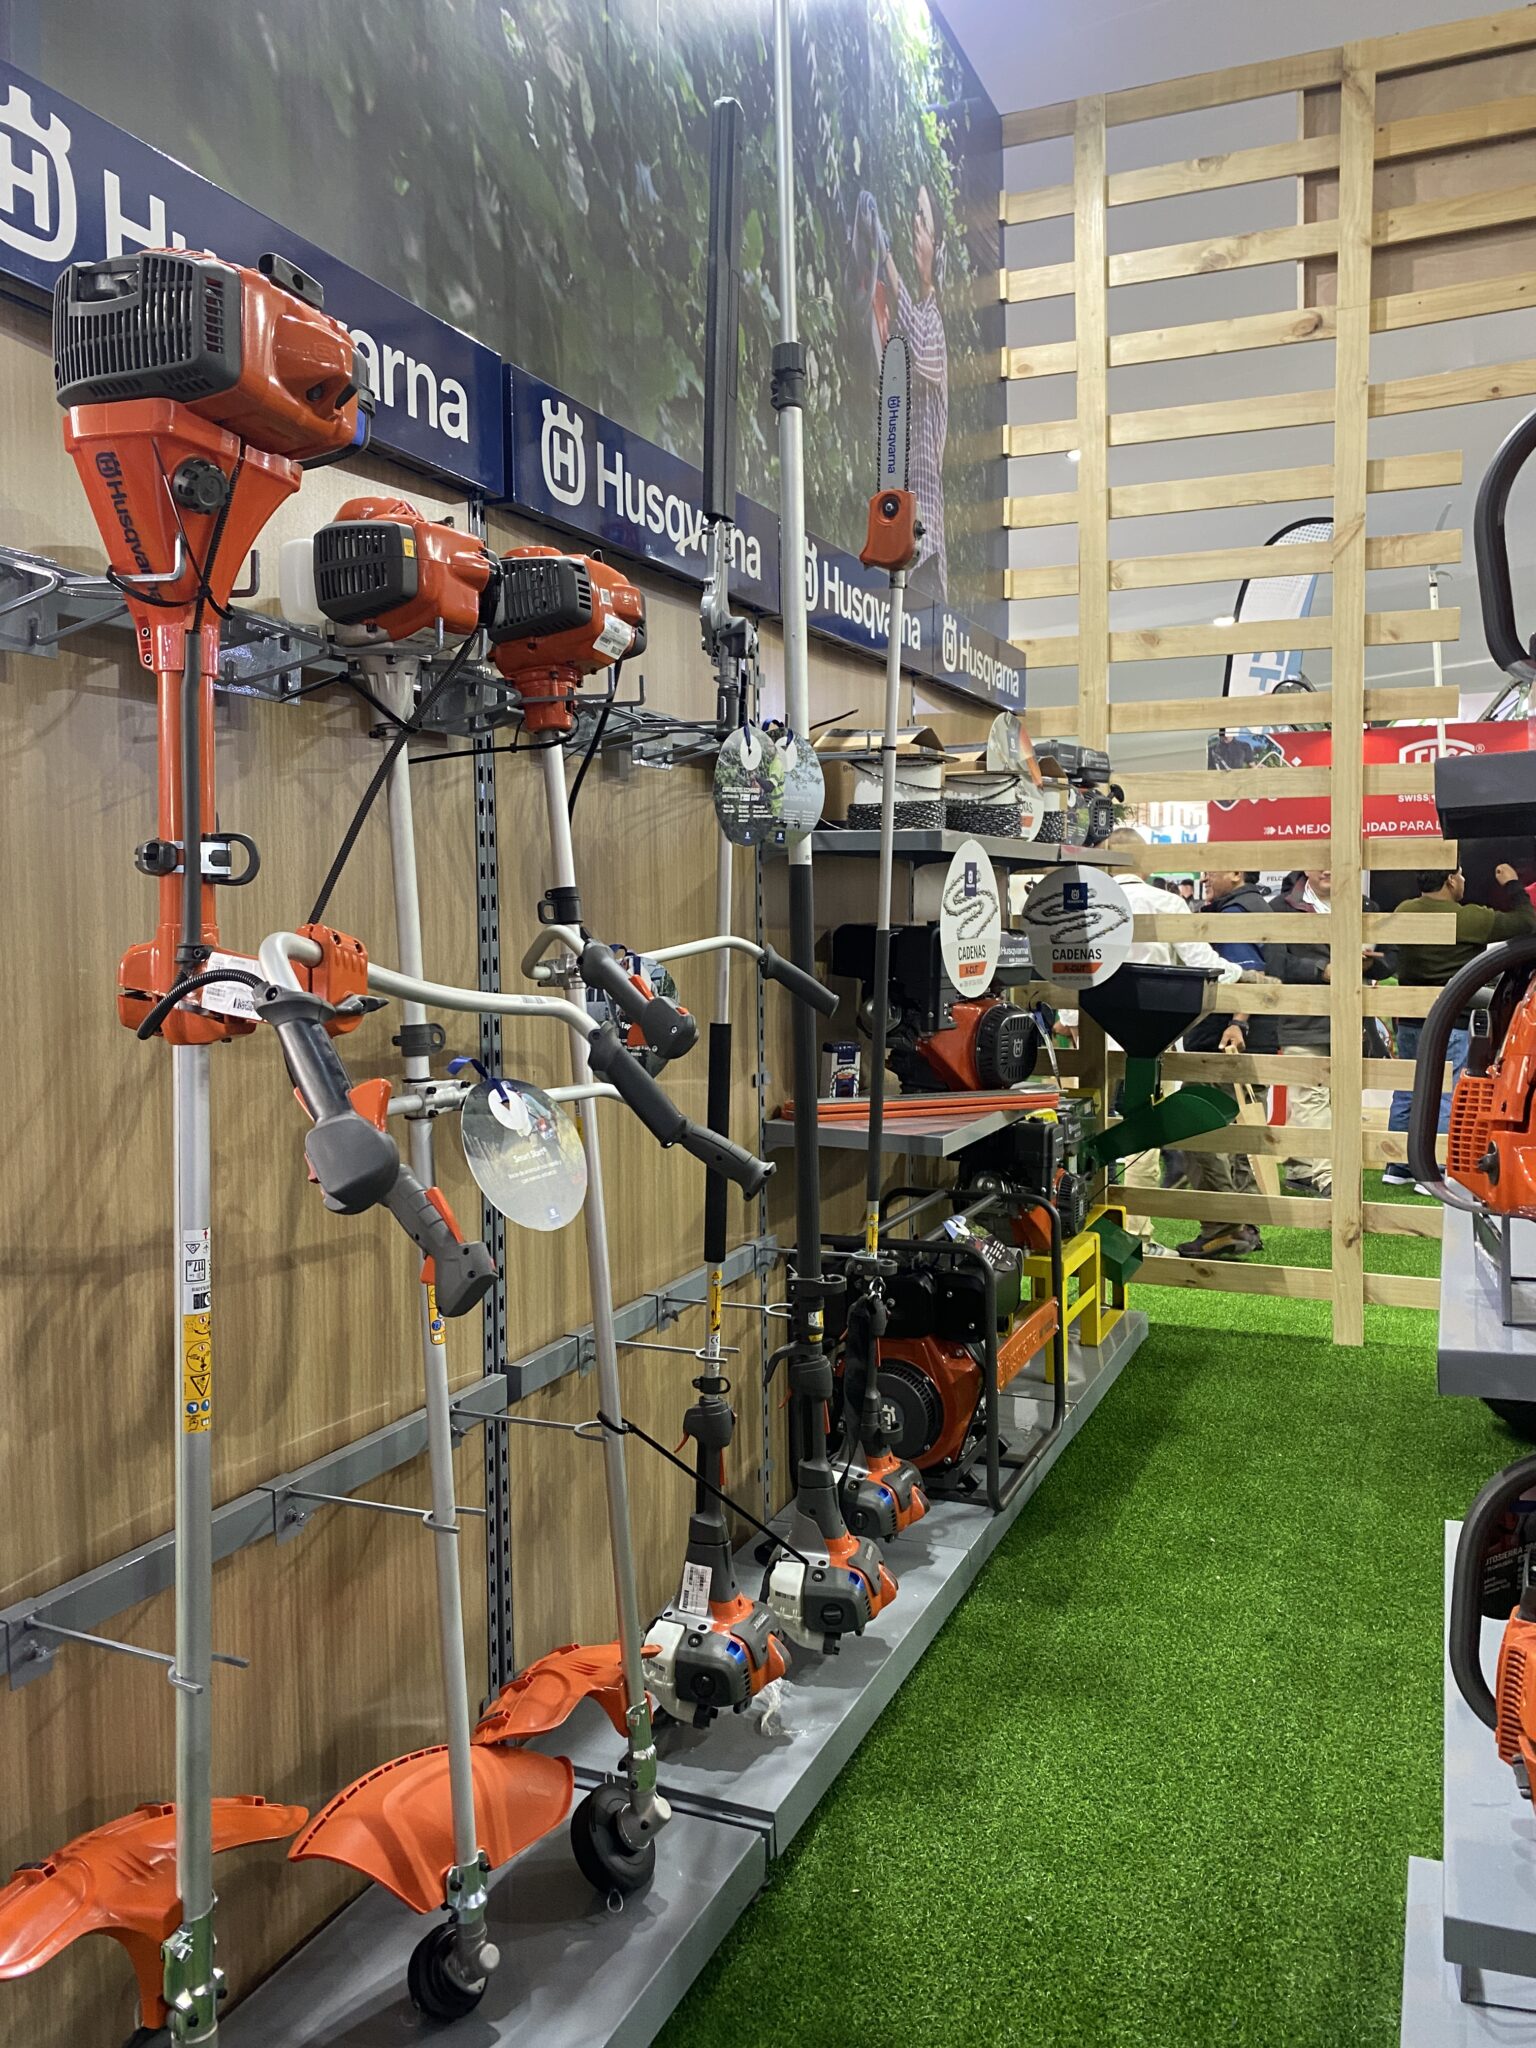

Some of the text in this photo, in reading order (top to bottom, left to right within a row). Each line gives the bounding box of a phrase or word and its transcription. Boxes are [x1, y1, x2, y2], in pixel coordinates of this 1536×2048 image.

[887, 409, 899, 474] Husqvarna
[959, 632, 1019, 698] Husqvarna
[1398, 793, 1429, 803] SWISS
[1278, 825, 1294, 836] LA
[1295, 824, 1331, 835] MEJO
[1399, 820, 1436, 832] PARA
[957, 945, 987, 961] CADENAS
[1052, 948, 1102, 960] CADENAS
